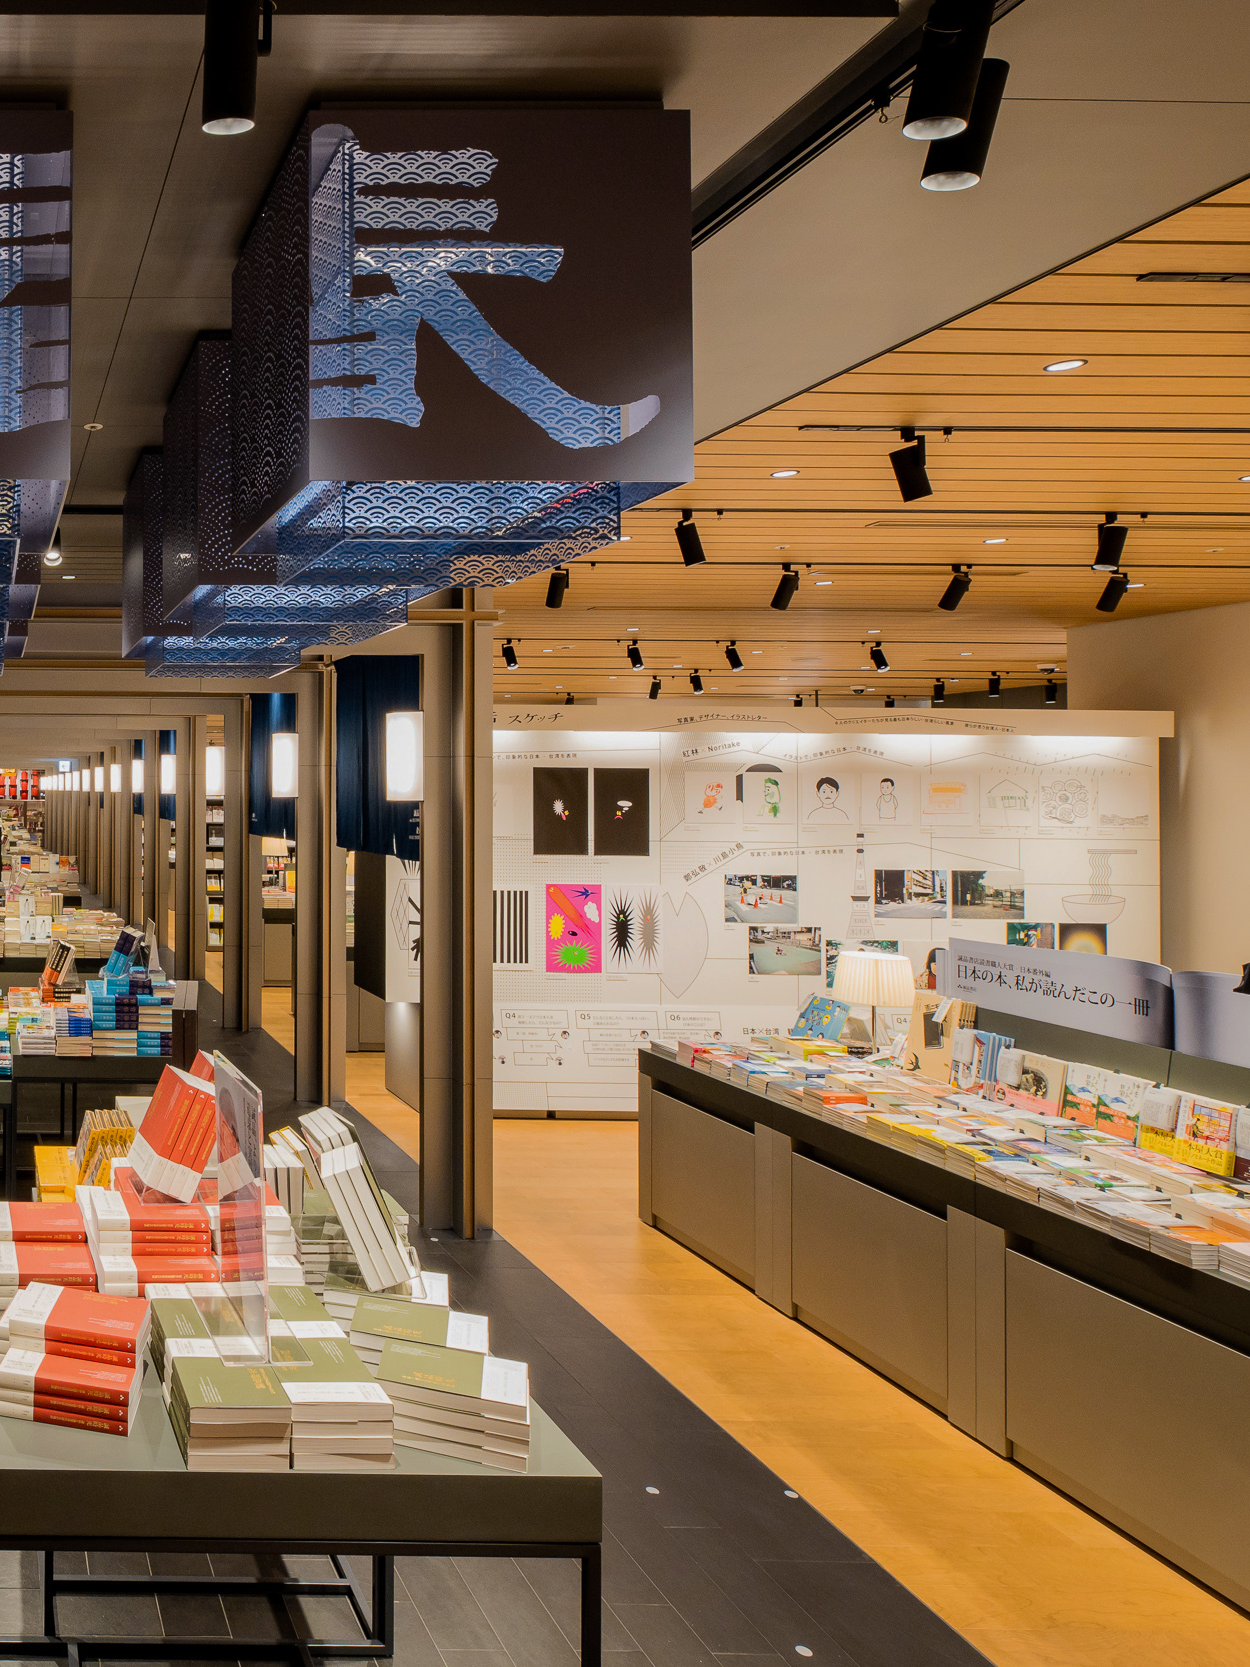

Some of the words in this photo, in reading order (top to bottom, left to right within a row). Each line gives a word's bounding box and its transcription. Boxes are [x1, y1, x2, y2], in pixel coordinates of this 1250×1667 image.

[508, 712, 564, 725] スケッチ
[957, 964, 1151, 1017] 日本の本、私が読んだこの一冊
[505, 1012, 516, 1020] Q4
[896, 1017, 908, 1025] Q4
[1185, 1142, 1225, 1161] 本屋大賞
